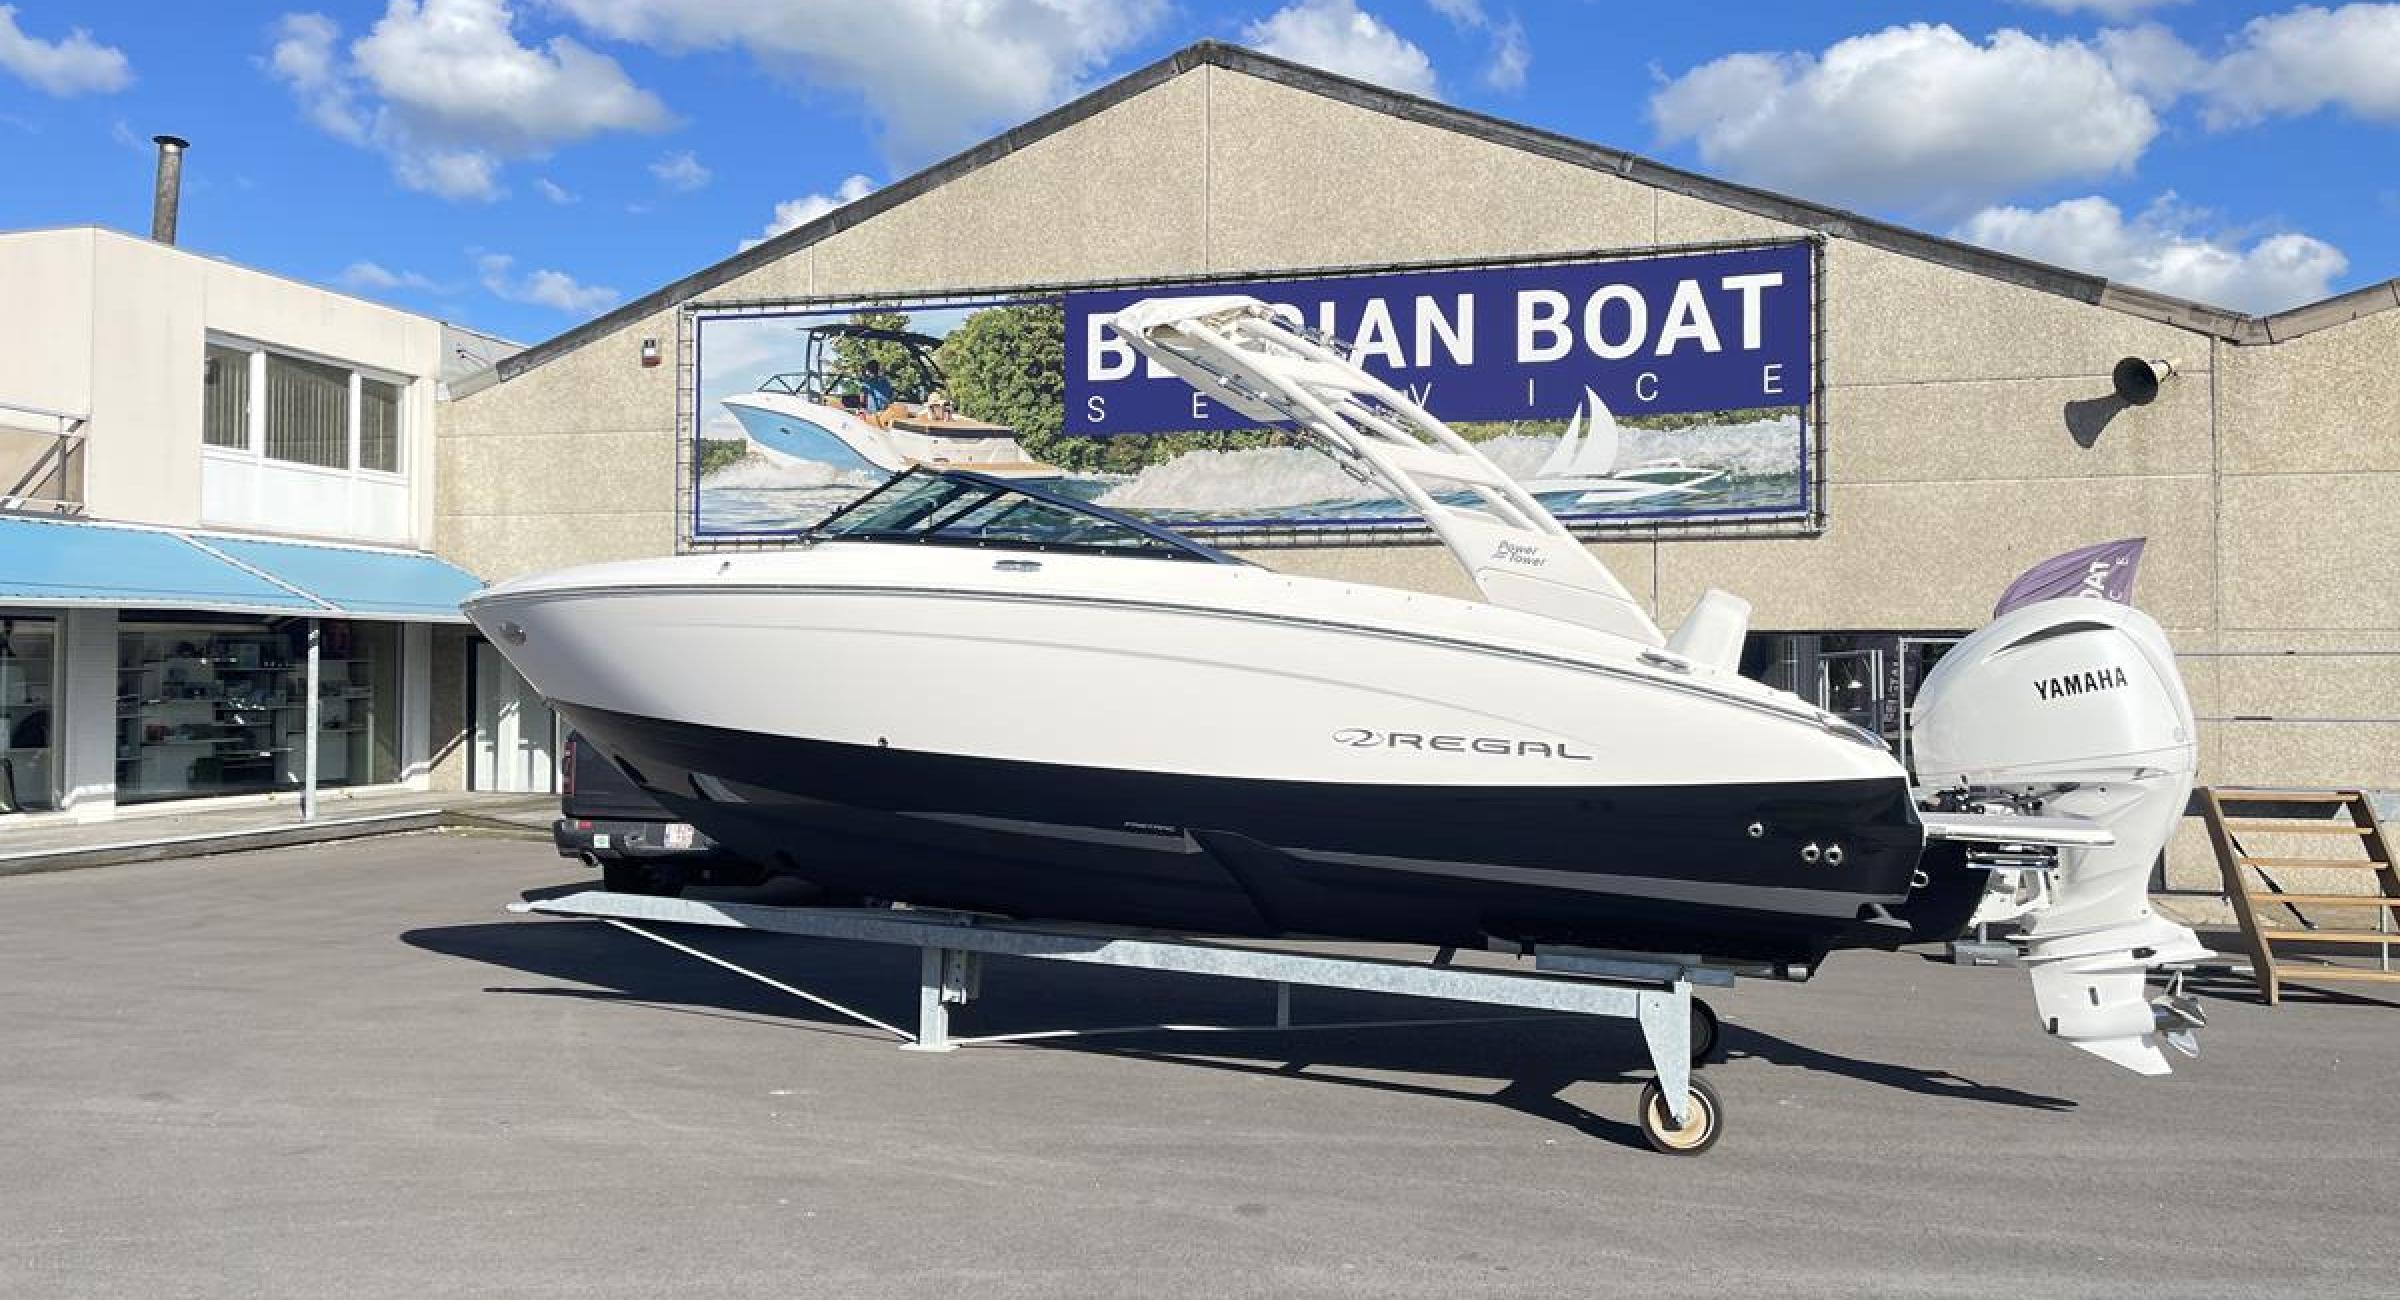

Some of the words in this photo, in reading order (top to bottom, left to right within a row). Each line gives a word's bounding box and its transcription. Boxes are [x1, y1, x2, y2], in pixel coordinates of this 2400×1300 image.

[1518, 271, 1783, 363] BOAT
[1088, 363, 1783, 423] SEVICE
[2033, 665, 2129, 701] YAMAHA
[1387, 732, 1594, 761] REGAL
